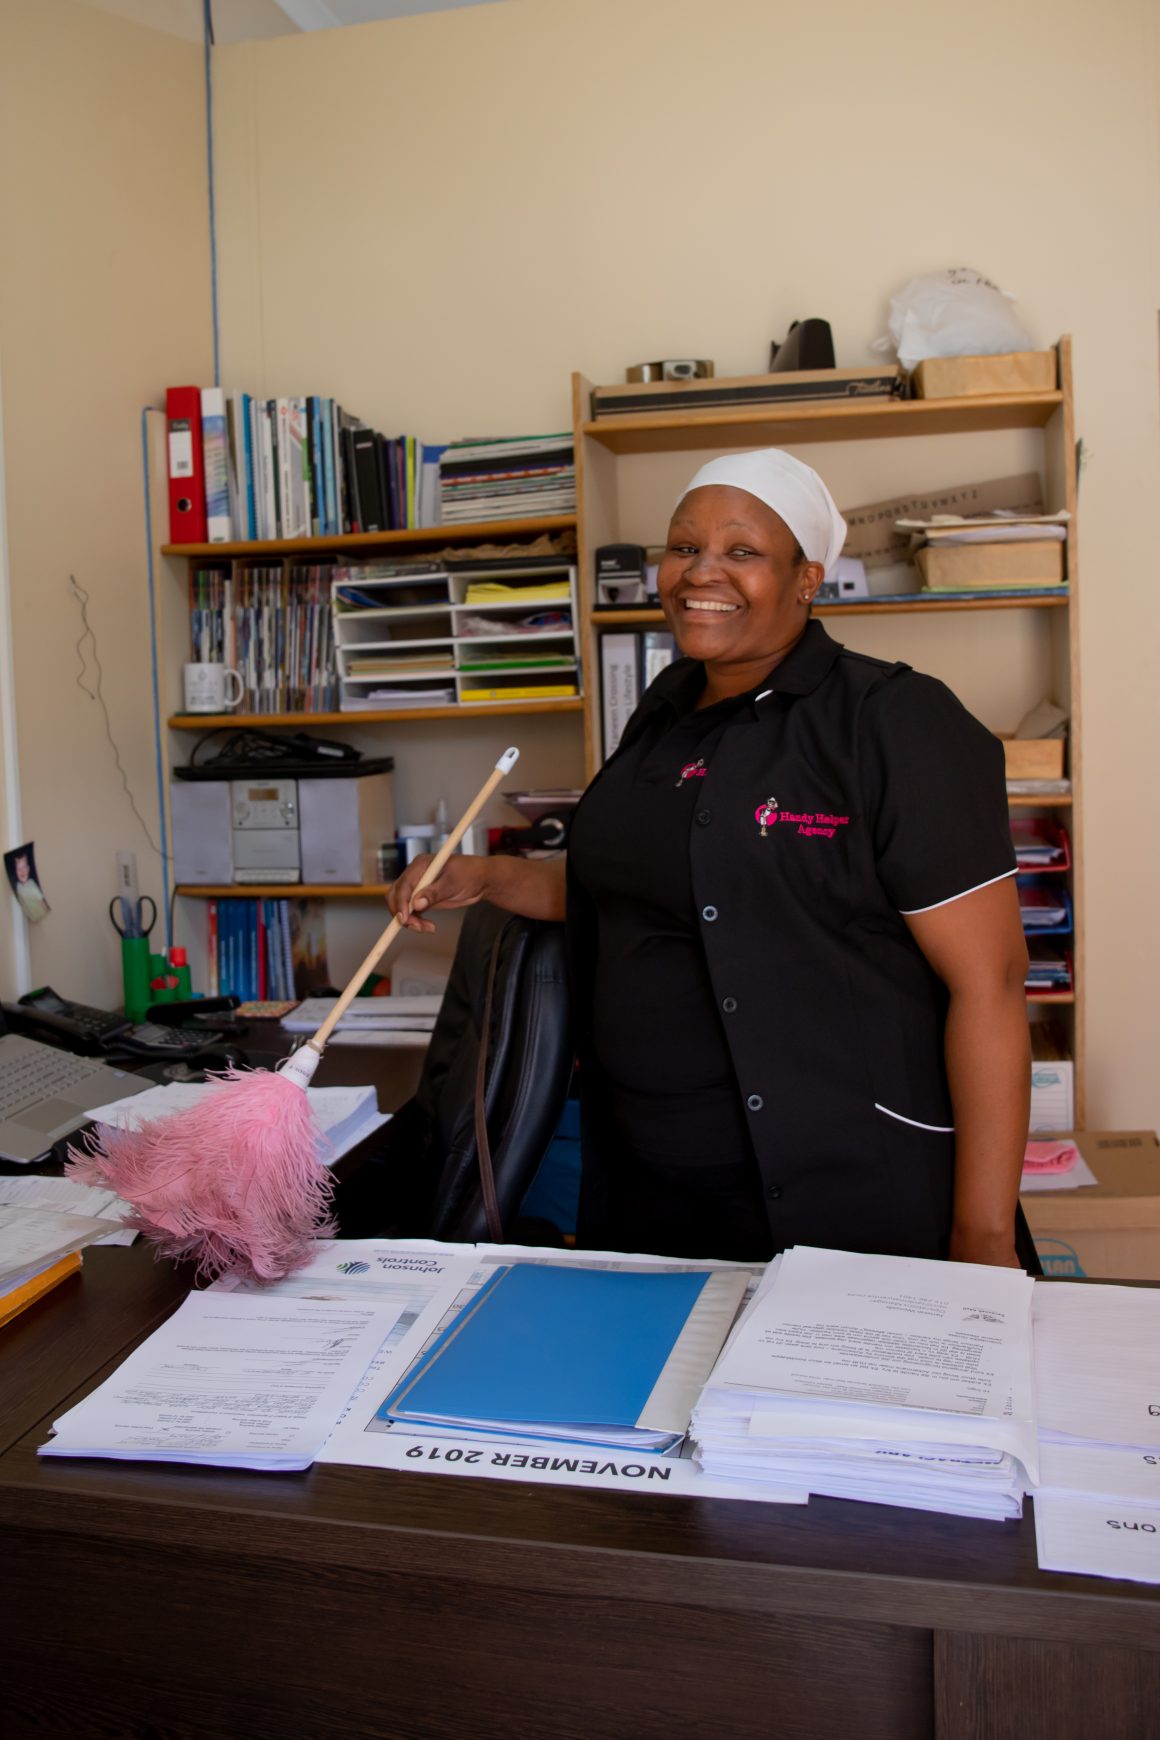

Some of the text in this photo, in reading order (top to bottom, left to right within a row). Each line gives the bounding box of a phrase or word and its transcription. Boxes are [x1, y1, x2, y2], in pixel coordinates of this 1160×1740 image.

[608, 664, 619, 707] Crossing
[623, 664, 634, 706] Lifestyle
[779, 812, 850, 827] Handy Helper
[797, 824, 836, 839] Agency
[375, 1257, 438, 1267] Controls
[382, 1264, 445, 1274] Johnson
[405, 1445, 672, 1481] NOVEMBER 2019
